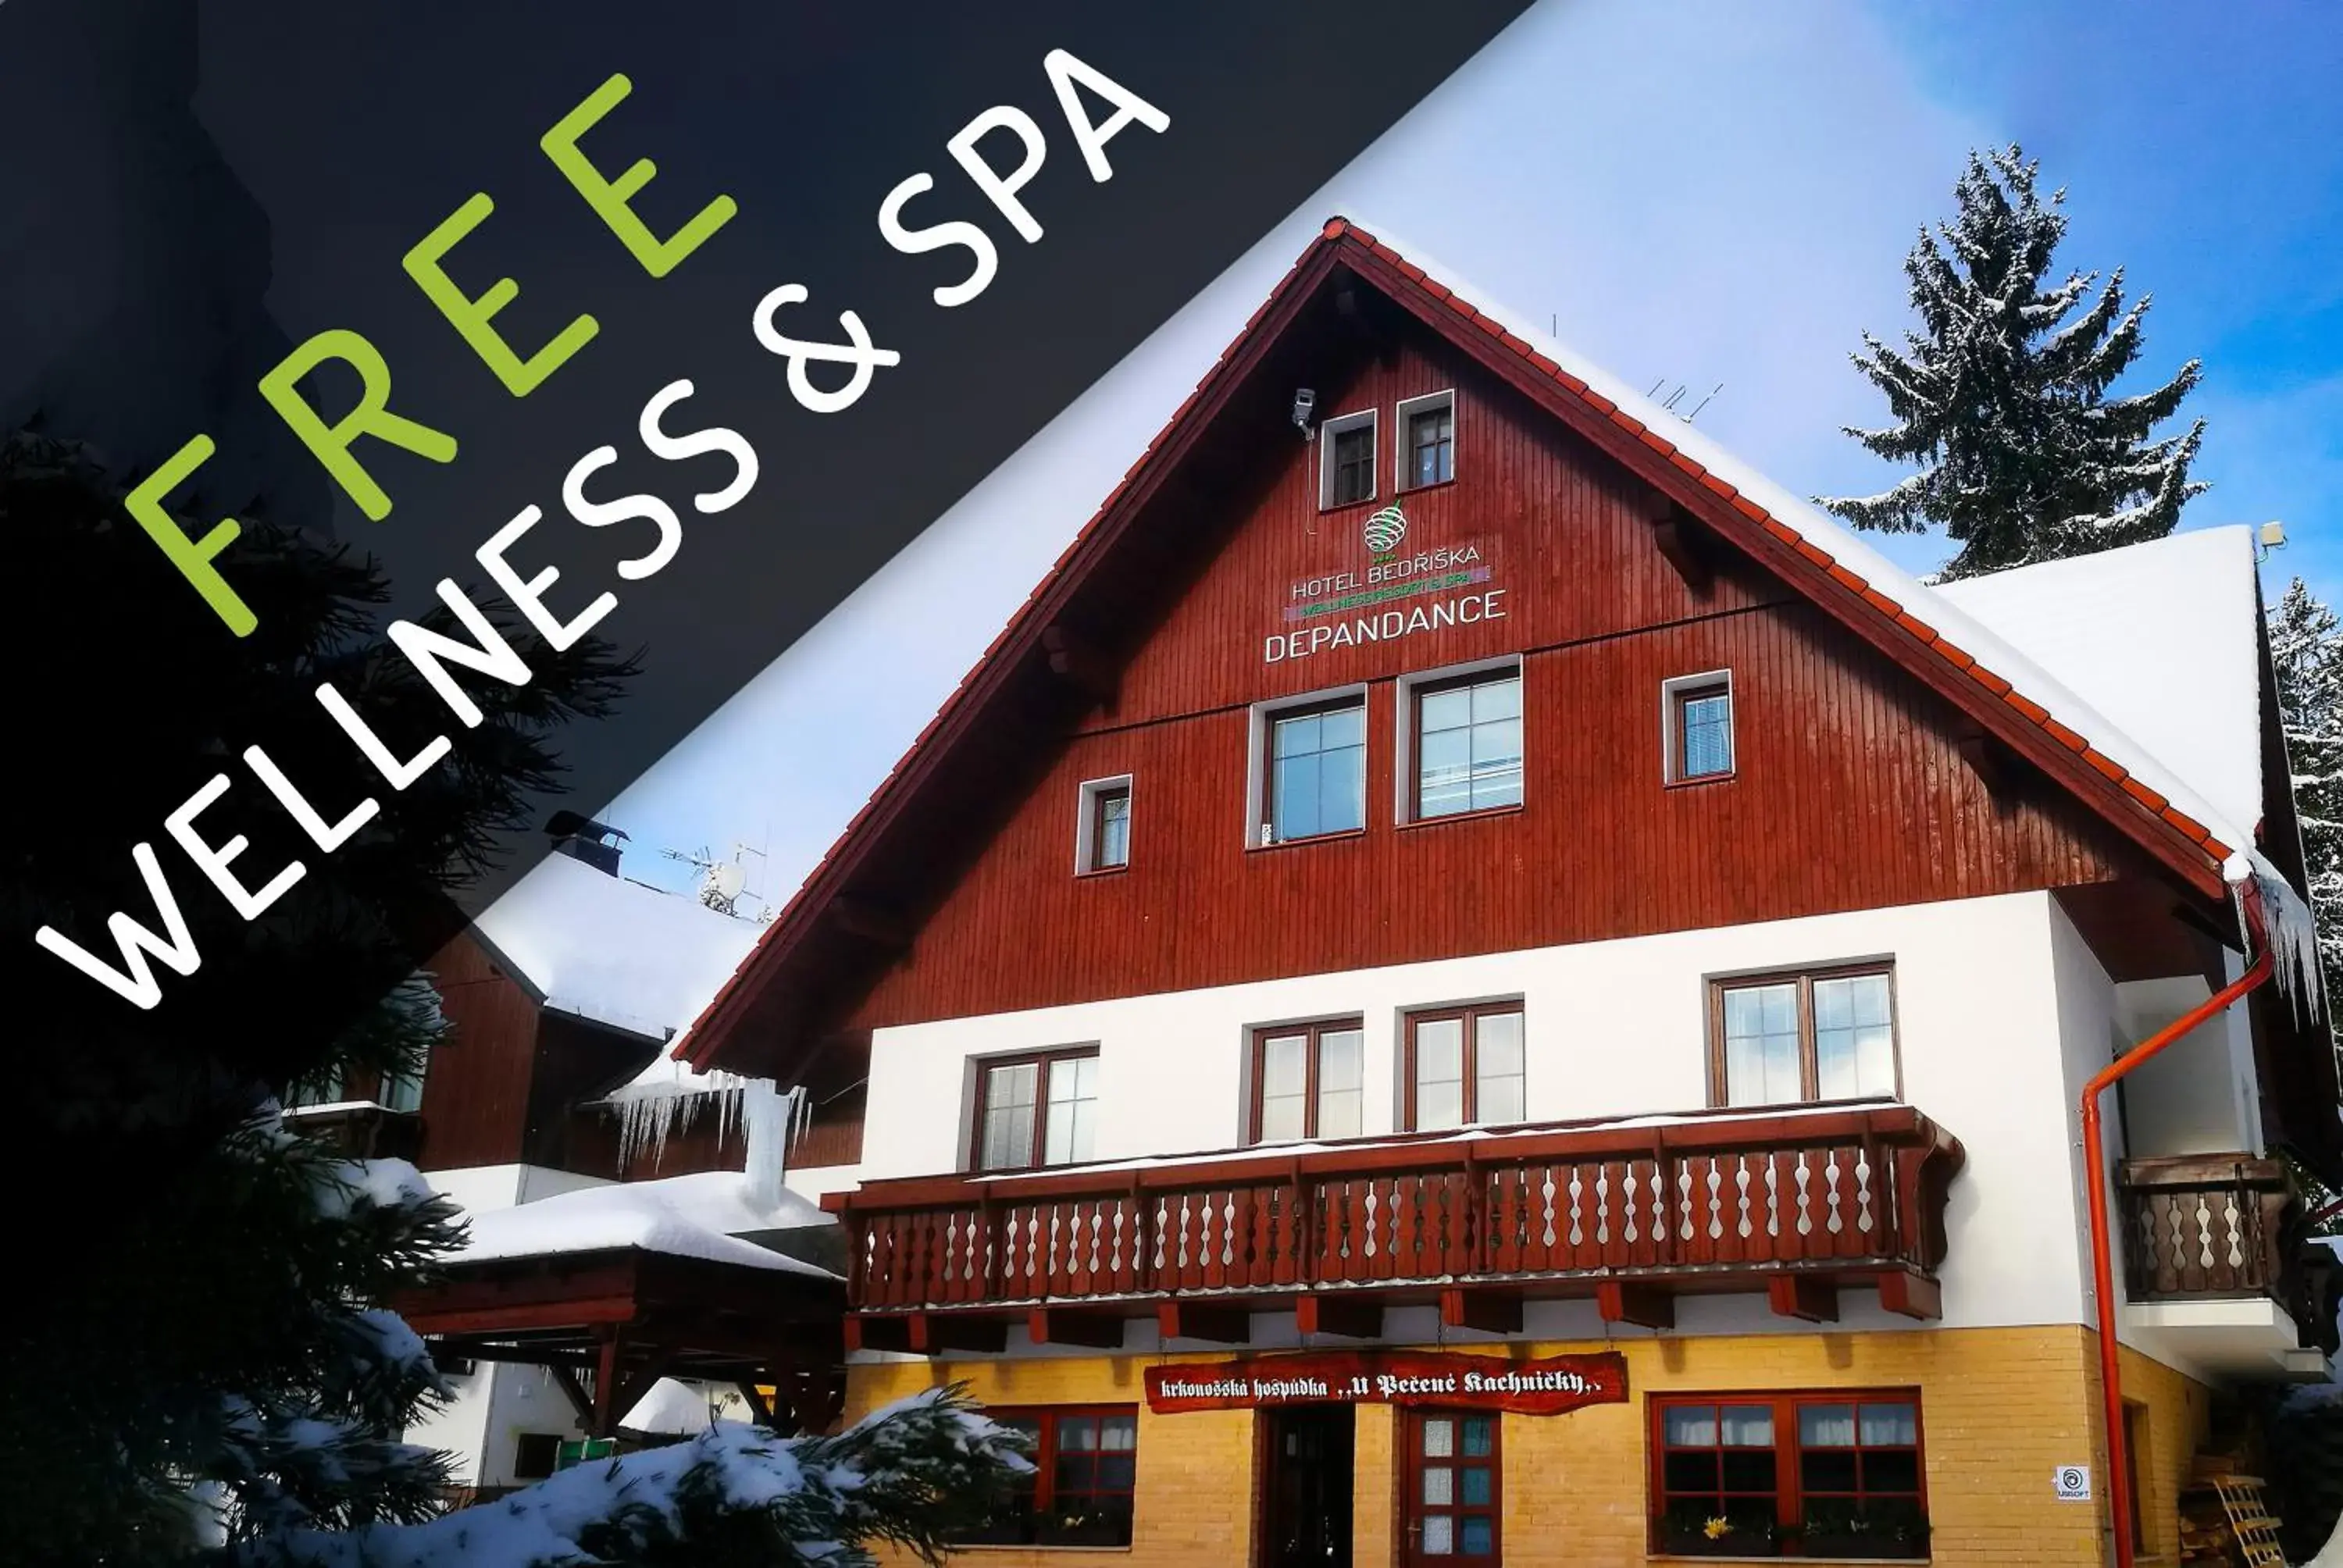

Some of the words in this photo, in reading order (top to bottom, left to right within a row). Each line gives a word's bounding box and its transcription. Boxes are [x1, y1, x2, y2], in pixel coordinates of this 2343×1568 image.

[1292, 572, 1362, 600] HOTEL
[1368, 544, 1480, 584] BEDŘIŠKA
[1264, 590, 1507, 663] DEPANDANCE
